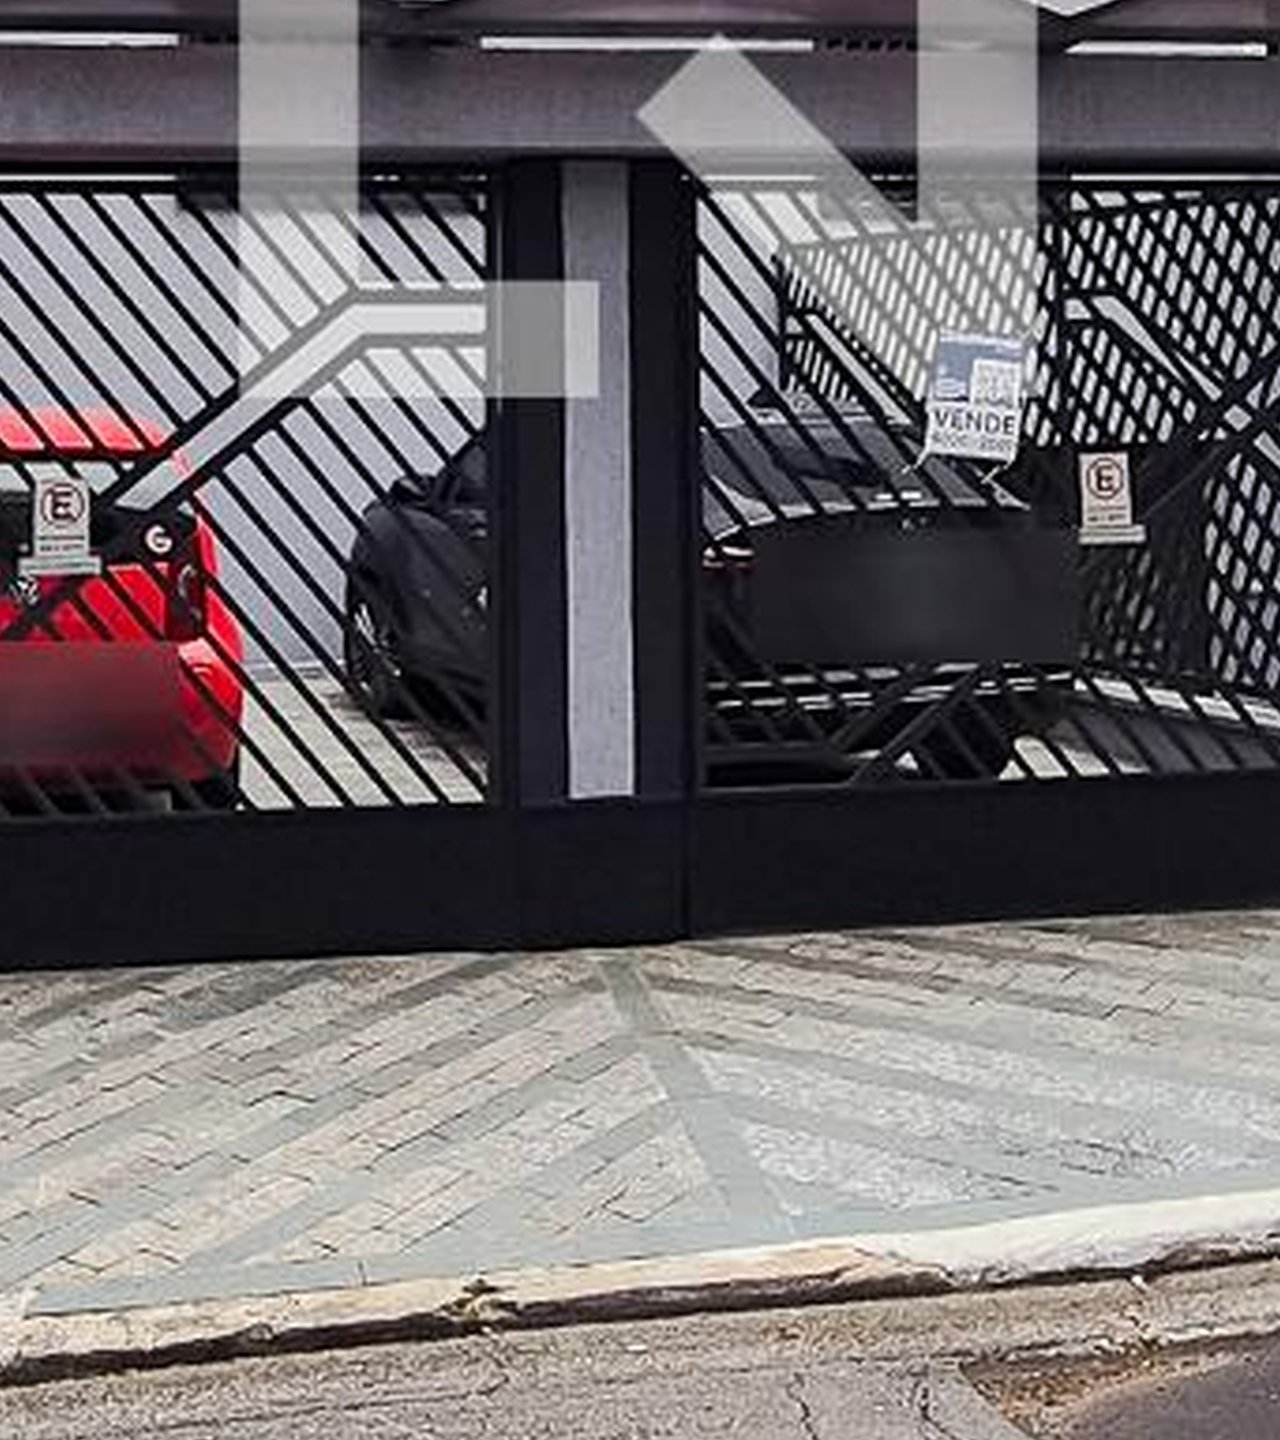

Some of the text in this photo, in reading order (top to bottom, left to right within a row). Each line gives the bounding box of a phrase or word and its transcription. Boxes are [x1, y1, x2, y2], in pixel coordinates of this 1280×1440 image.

[934, 407, 1016, 436] VENDE
[1096, 465, 1114, 491] E
[52, 491, 74, 520] E
